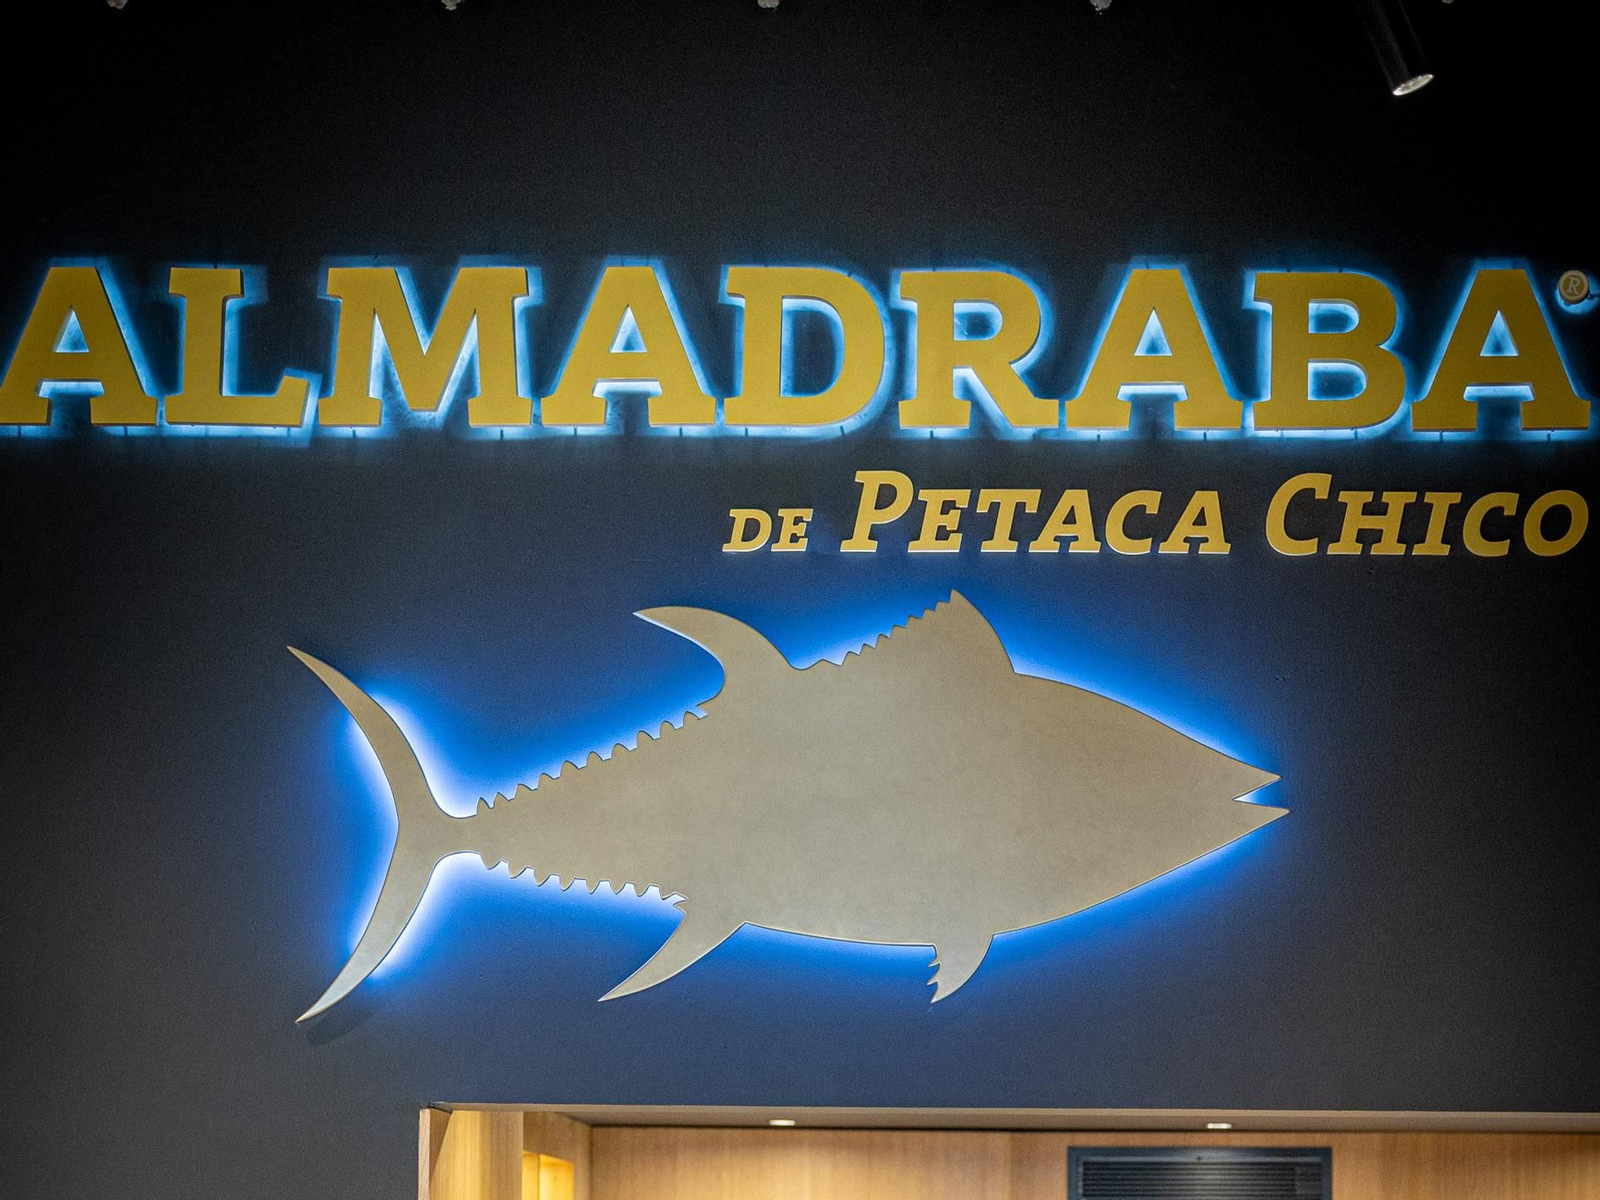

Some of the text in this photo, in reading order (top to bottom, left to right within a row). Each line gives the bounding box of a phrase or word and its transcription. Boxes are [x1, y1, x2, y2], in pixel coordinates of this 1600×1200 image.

[722, 470, 1589, 556] DE PETACA CHICO
